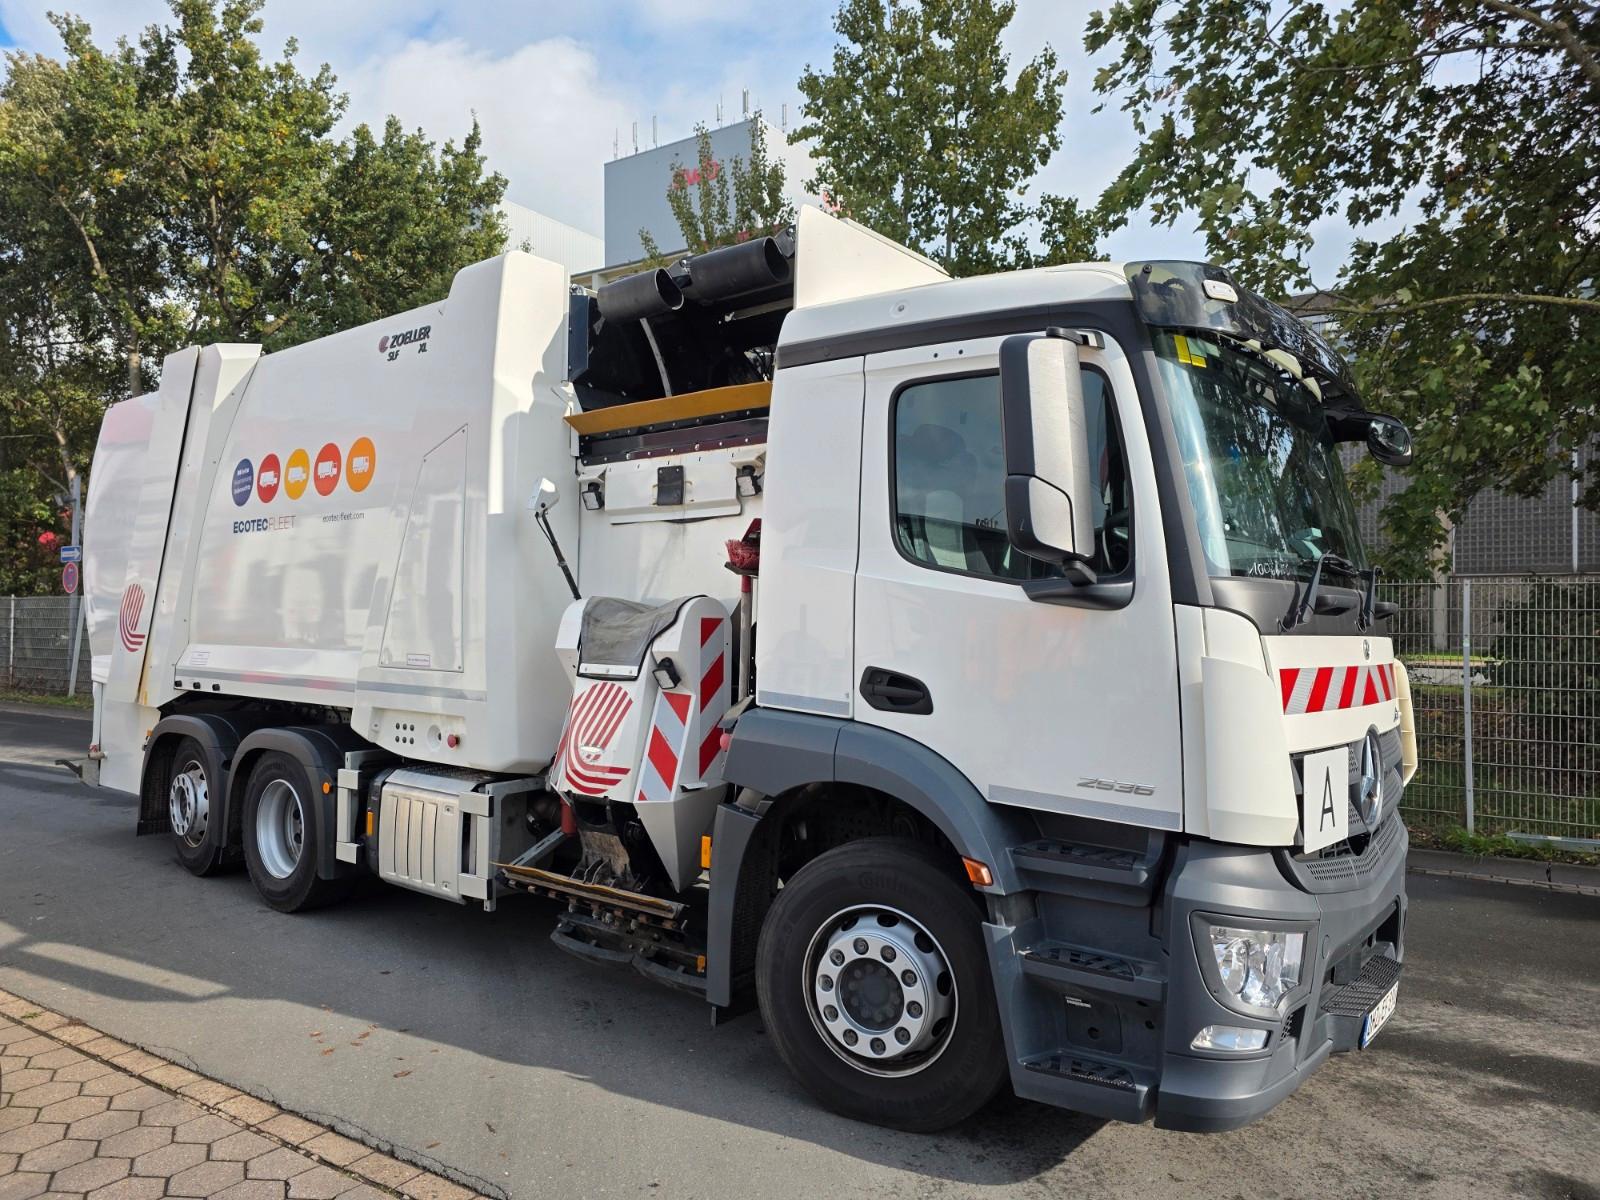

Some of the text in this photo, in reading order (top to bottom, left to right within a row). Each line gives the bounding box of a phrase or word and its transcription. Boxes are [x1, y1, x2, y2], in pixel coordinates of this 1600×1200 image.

[390, 325, 431, 349] ZOELLER
[418, 342, 428, 354] XL
[233, 515, 296, 534] ECOTECFLEET
[1077, 777, 1155, 796] 2536
[1319, 766, 1335, 832] A
